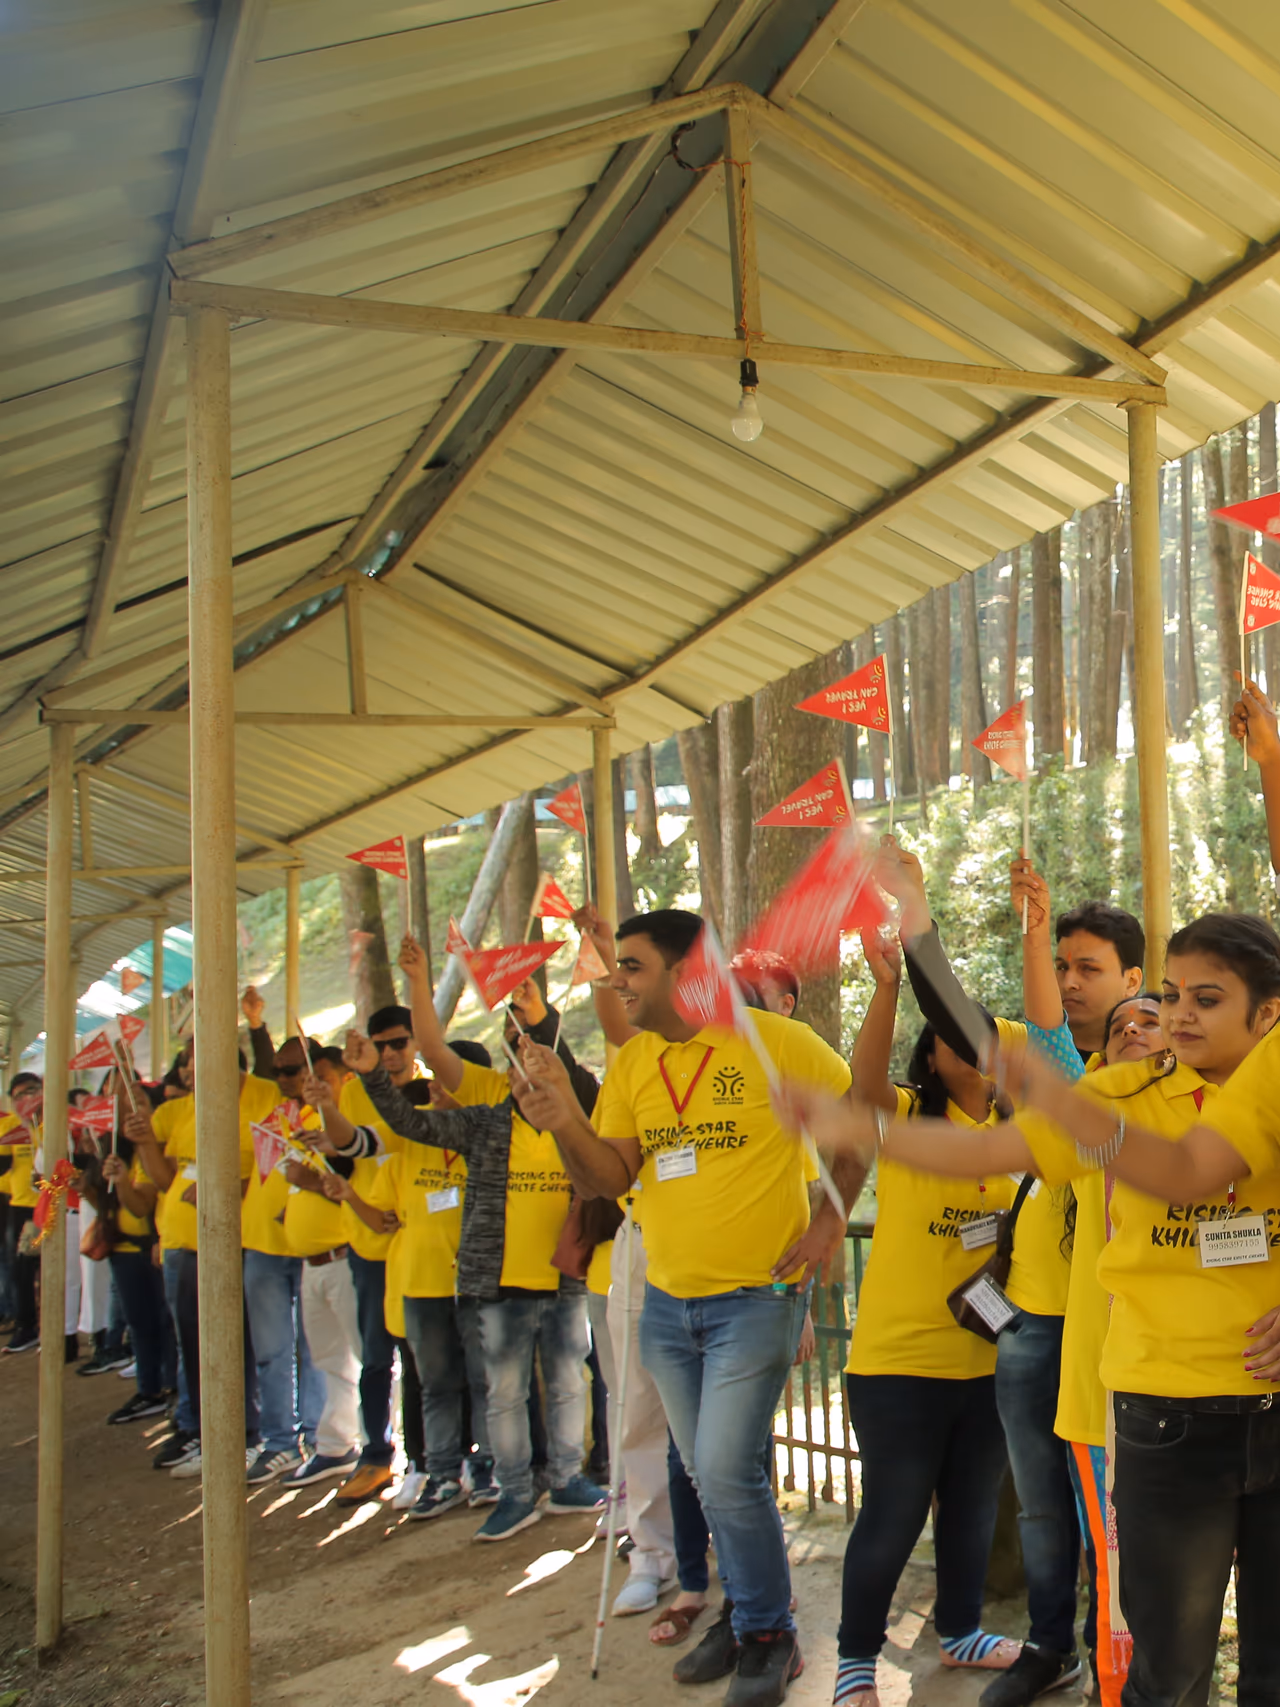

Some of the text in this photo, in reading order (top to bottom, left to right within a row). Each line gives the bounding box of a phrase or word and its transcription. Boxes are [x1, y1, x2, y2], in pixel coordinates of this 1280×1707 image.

[825, 686, 878, 704] CAN TRAVEL
[848, 699, 867, 713] YES
[781, 789, 834, 815] CAN TRAVEL
[804, 802, 825, 818] YES
[696, 1120, 737, 1135] STAR
[942, 1206, 986, 1223] RISIN
[1205, 1227, 1262, 1242] SUNITA SHUKLA
